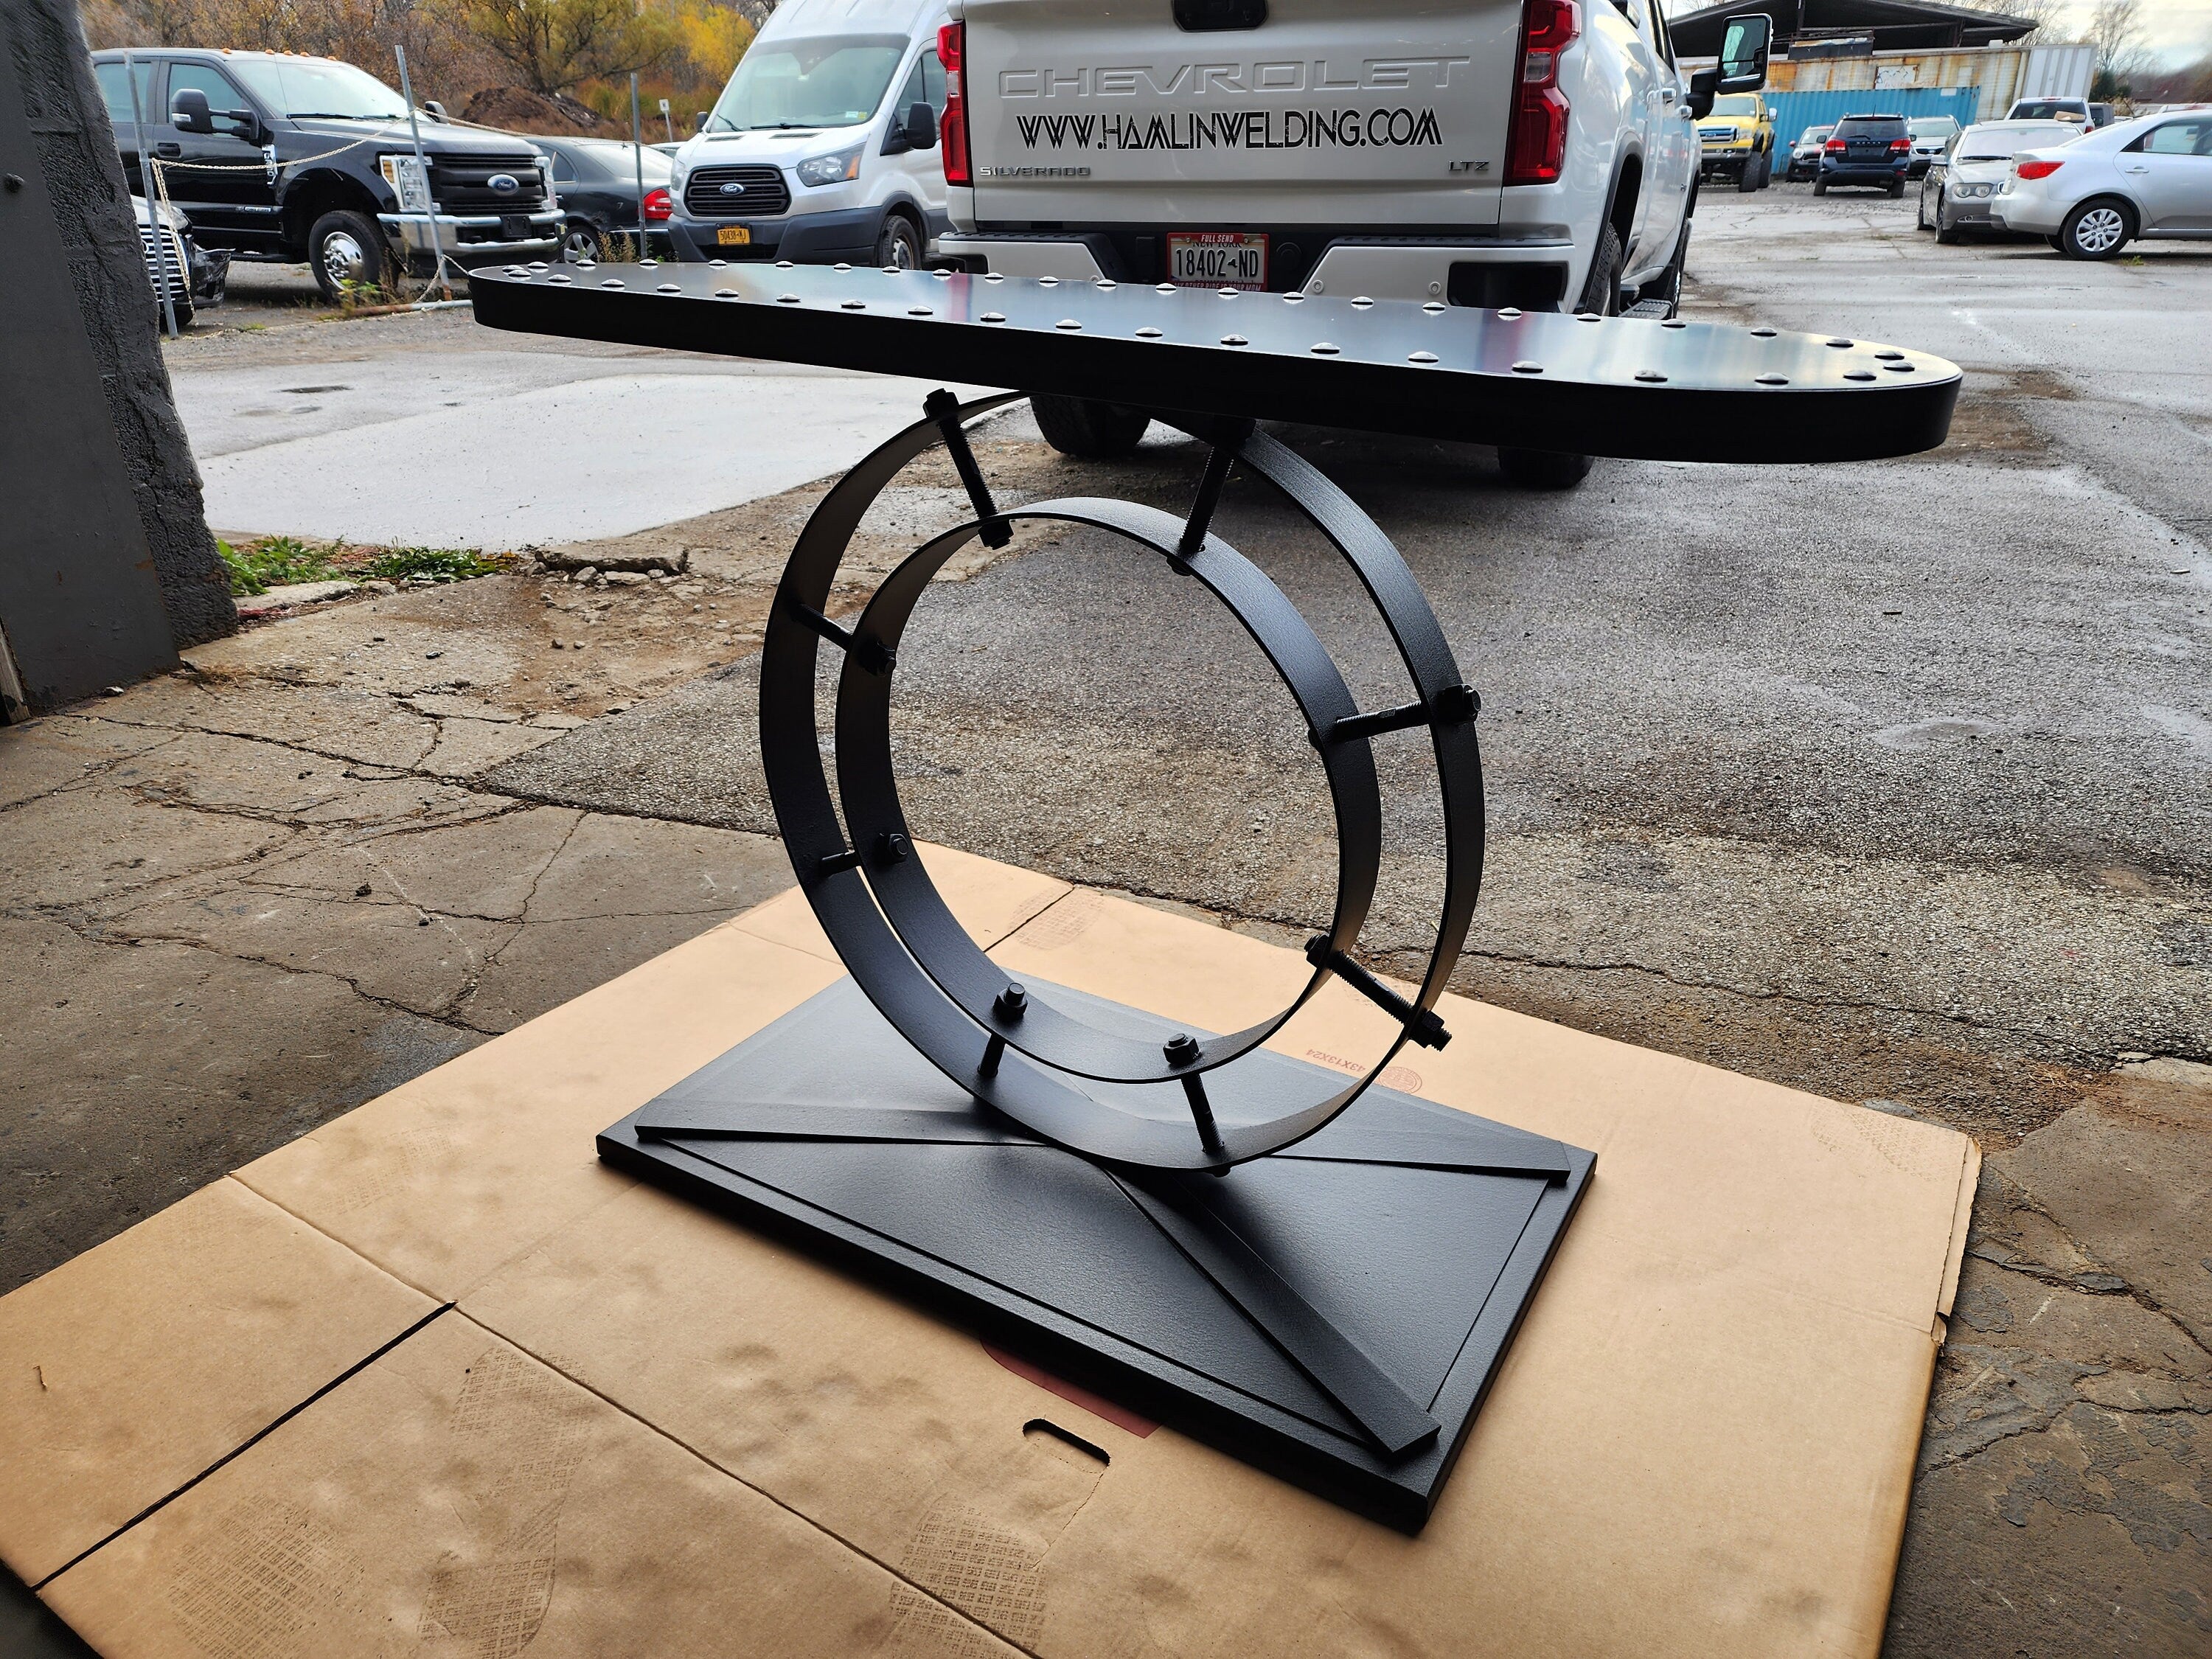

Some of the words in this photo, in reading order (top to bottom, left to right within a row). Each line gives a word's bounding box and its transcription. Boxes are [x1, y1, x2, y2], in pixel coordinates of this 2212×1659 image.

[998, 55, 1470, 98] CHEVROLET
[1016, 107, 1443, 150] WWW.HAMLINWELDING.COM
[979, 166, 1091, 176] SILVERADO
[1449, 159, 1489, 171] LTZ
[1201, 234, 1216, 243] FULL
[1217, 234, 1234, 243] SEND
[1306, 1049, 1366, 1073] 43X13X24
